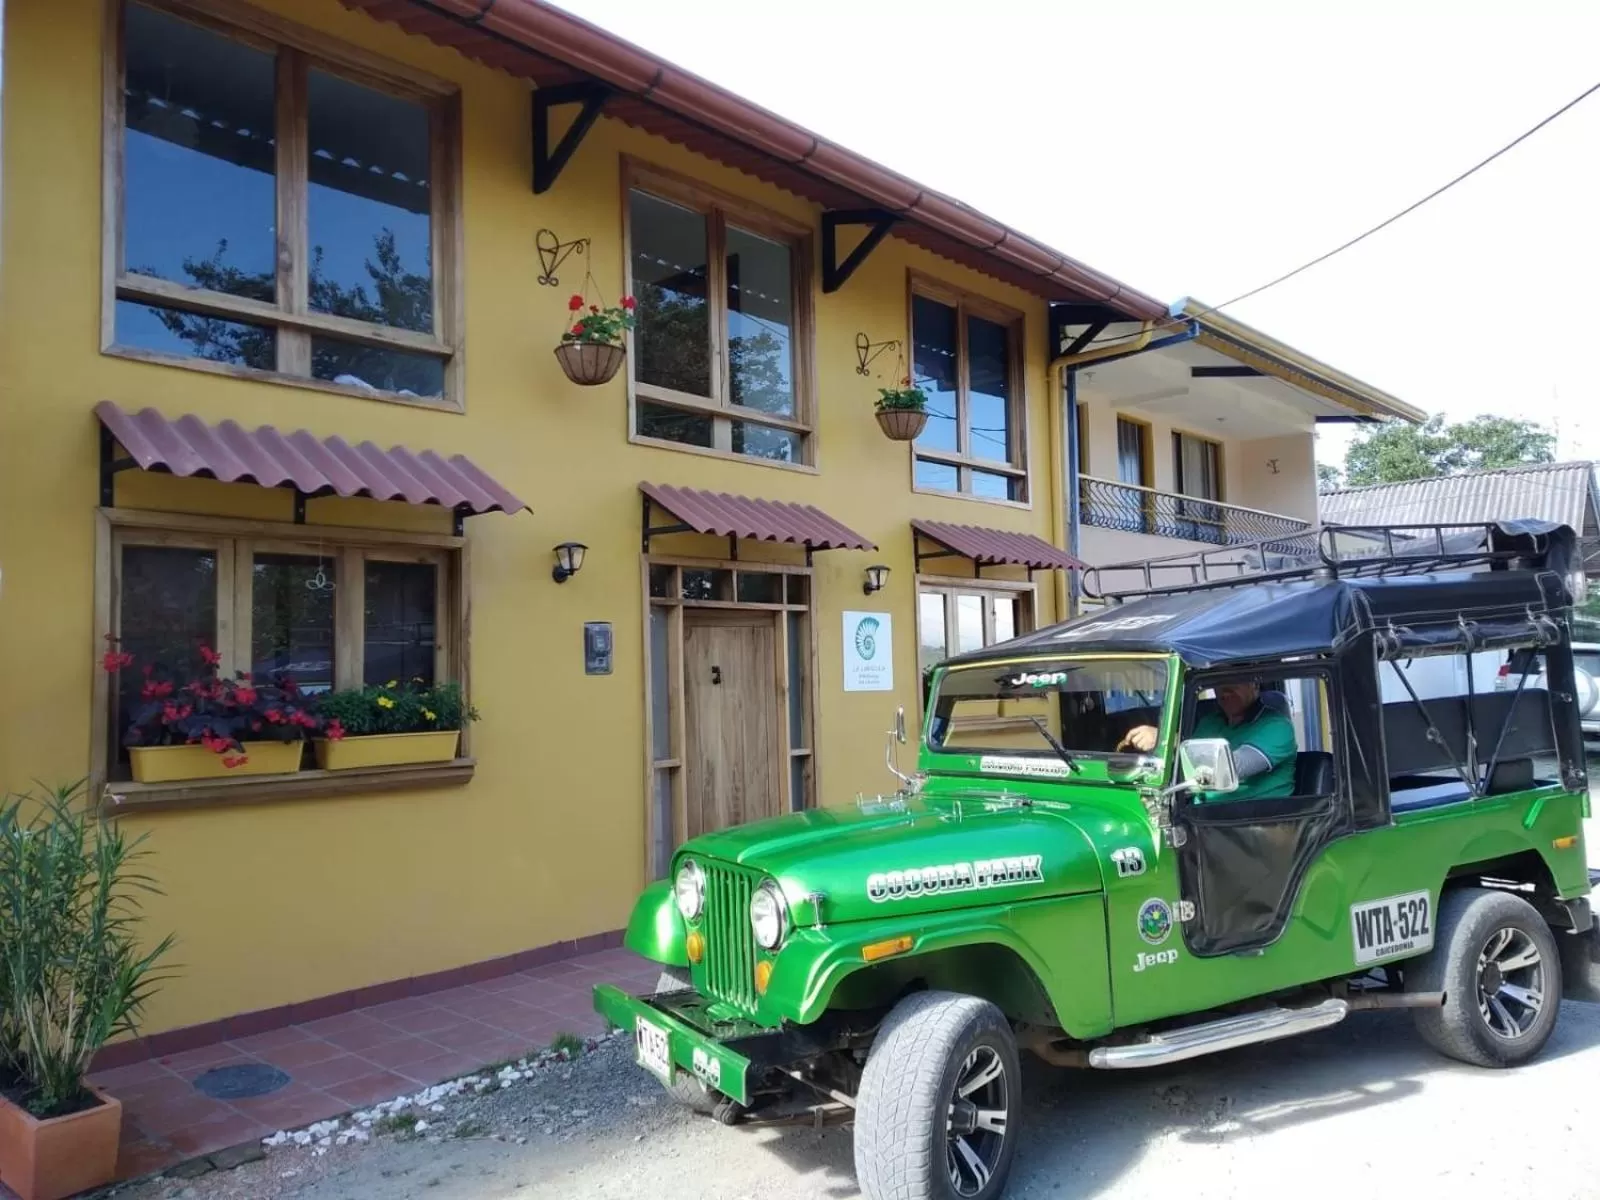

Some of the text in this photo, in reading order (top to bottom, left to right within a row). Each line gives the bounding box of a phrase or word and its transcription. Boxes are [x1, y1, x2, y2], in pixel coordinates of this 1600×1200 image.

[1011, 672, 1067, 688] Jeep
[974, 855, 1044, 889] PARK
[1133, 949, 1179, 973] Jeep
